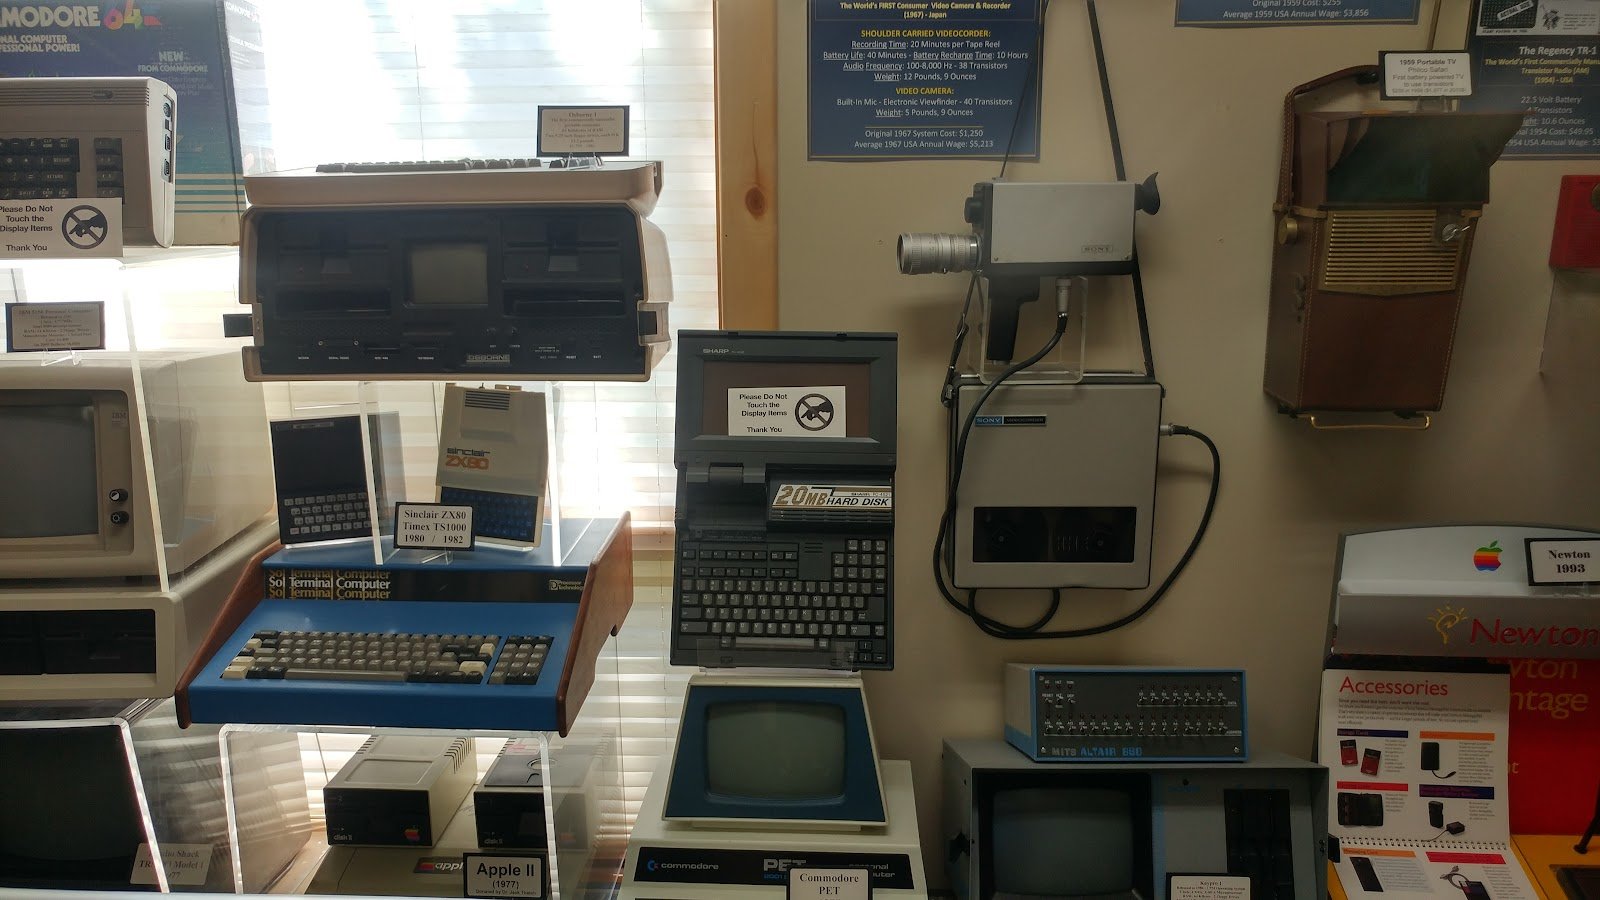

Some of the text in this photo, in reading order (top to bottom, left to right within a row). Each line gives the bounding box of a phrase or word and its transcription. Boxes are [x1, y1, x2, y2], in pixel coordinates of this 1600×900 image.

[897, 2, 929, 10] Consumer
[931, 2, 949, 10] Video
[951, 2, 975, 10] Camera
[982, 2, 1011, 10] Recorder
[0, 6, 101, 28] MODORE
[903, 11, 947, 19] (1967) Japan
[1223, 9, 1369, 20] Average 1959 USA Annual Wage: $3,856
[860, 29, 992, 38] SHOULDER CARRIED VIDEOCORDER:
[20, 35, 68, 43] COMPUTER
[45, 44, 81, 52] POWER!
[851, 40, 887, 50] Recording
[888, 40, 909, 50] Time:
[921, 40, 951, 48] Minutes
[952, 42, 964, 50] per
[965, 40, 983, 50] Tape
[985, 40, 1001, 48] Reel
[823, 51, 849, 61] Battery
[850, 51, 866, 61] Life:
[877, 51, 907, 59] Minutes
[913, 51, 939, 61] Battery
[940, 51, 973, 61] Recharge
[974, 51, 995, 61] Time:
[1007, 51, 1028, 59] Hours
[1519, 46, 1598, 57] The Regency TR-1
[137, 64, 209, 73] FROM COMMODORE
[843, 62, 864, 72] Audio
[865, 62, 905, 72] Frequency:
[906, 62, 942, 71] 100-8,000
[970, 62, 1008, 70] Transistors
[1521, 67, 1554, 75] Transistor
[873, 72, 902, 82] Weight:
[914, 72, 942, 81] Pounds,
[950, 72, 977, 80] Ounces
[895, 87, 955, 95] VIDEO CAMERA:
[837, 98, 1013, 106] Built-In Mic Electronic Viewfinder 40 Transistors
[1521, 96, 1582, 105] 22.5 Volt Battery
[875, 108, 974, 118] Weight: Pounds, Ounces
[864, 129, 984, 139] Original 1967 System Cost: $1,250
[854, 140, 994, 150] Average 1967 USA Annual Wage: $5,213
[1523, 138, 1539, 146] USA
[0, 205, 23, 213] Please
[0, 224, 53, 233] Display Items
[6, 244, 31, 252] Thank
[741, 410, 767, 418] Display
[447, 447, 491, 457] sinclair
[446, 455, 490, 471] ZX80
[775, 485, 889, 507] 20MB HARD DISK
[404, 509, 467, 520] Sinclair ZX80
[403, 521, 467, 532] Timex TS1000
[405, 534, 464, 544] 1980 1982
[1548, 549, 1591, 560] Newton
[1556, 564, 1586, 574] 1993
[268, 576, 391, 592] Sol Terminal Computer
[1470, 618, 1600, 647] Newton
[1339, 675, 1449, 697] Accessories
[1511, 690, 1589, 719] ntage
[1052, 747, 1077, 756] MITS
[1080, 745, 1116, 756] ALTAIR
[435, 862, 464, 871] appl
[476, 862, 535, 878] Apple II
[660, 861, 720, 870] commodore
[799, 873, 860, 883] Commodore
[492, 880, 520, 889] (1977)
[819, 886, 841, 895] PET
